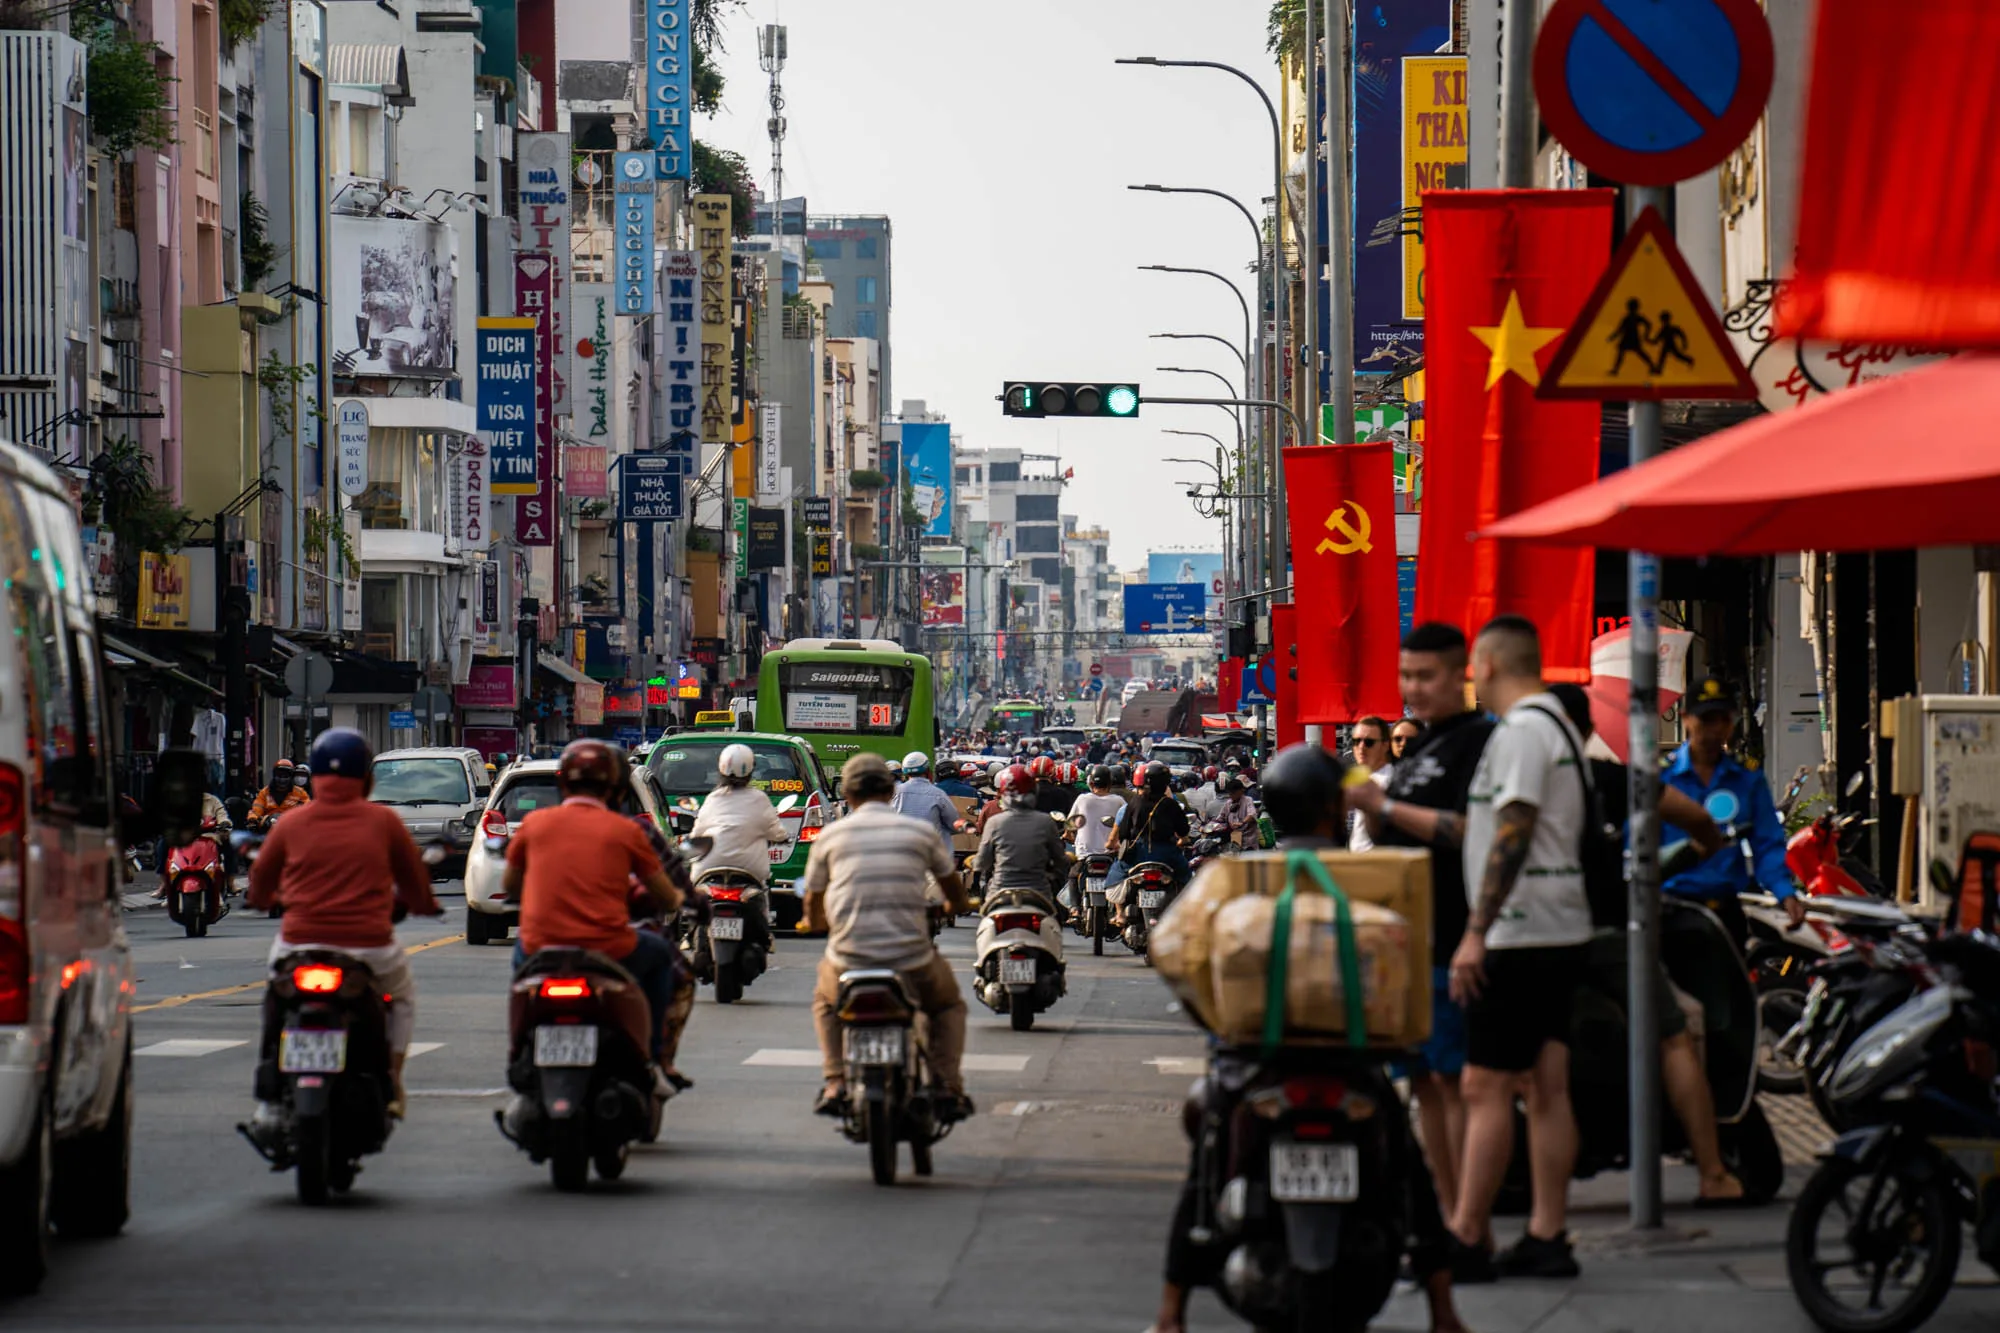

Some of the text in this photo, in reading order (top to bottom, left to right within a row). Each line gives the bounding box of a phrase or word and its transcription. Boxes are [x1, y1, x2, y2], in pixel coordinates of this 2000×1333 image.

[656, 85, 683, 174] CHÂU
[528, 168, 558, 184] NHÀ
[520, 187, 567, 204] THUỐC
[626, 197, 644, 250] LONG
[669, 279, 694, 354] NHỊ
[486, 337, 526, 356] DỊCH
[480, 360, 533, 383] THUẬT
[588, 296, 612, 439] Dalat Hasfarm
[701, 343, 725, 438] PHÁT
[488, 404, 526, 420] VISA
[341, 434, 366, 443] TRANG
[490, 428, 524, 450] VIỆT
[767, 406, 776, 490] THE FACE SHOP
[506, 455, 533, 474] TÍN
[641, 476, 665, 488] NHÀ
[634, 488, 671, 501] THUỐC
[633, 502, 673, 516] GIÁ TỐT
[805, 502, 829, 511] BEAUTY
[811, 672, 880, 683] SaigonBus
[871, 704, 891, 725] 31
[771, 779, 804, 792] 1055
